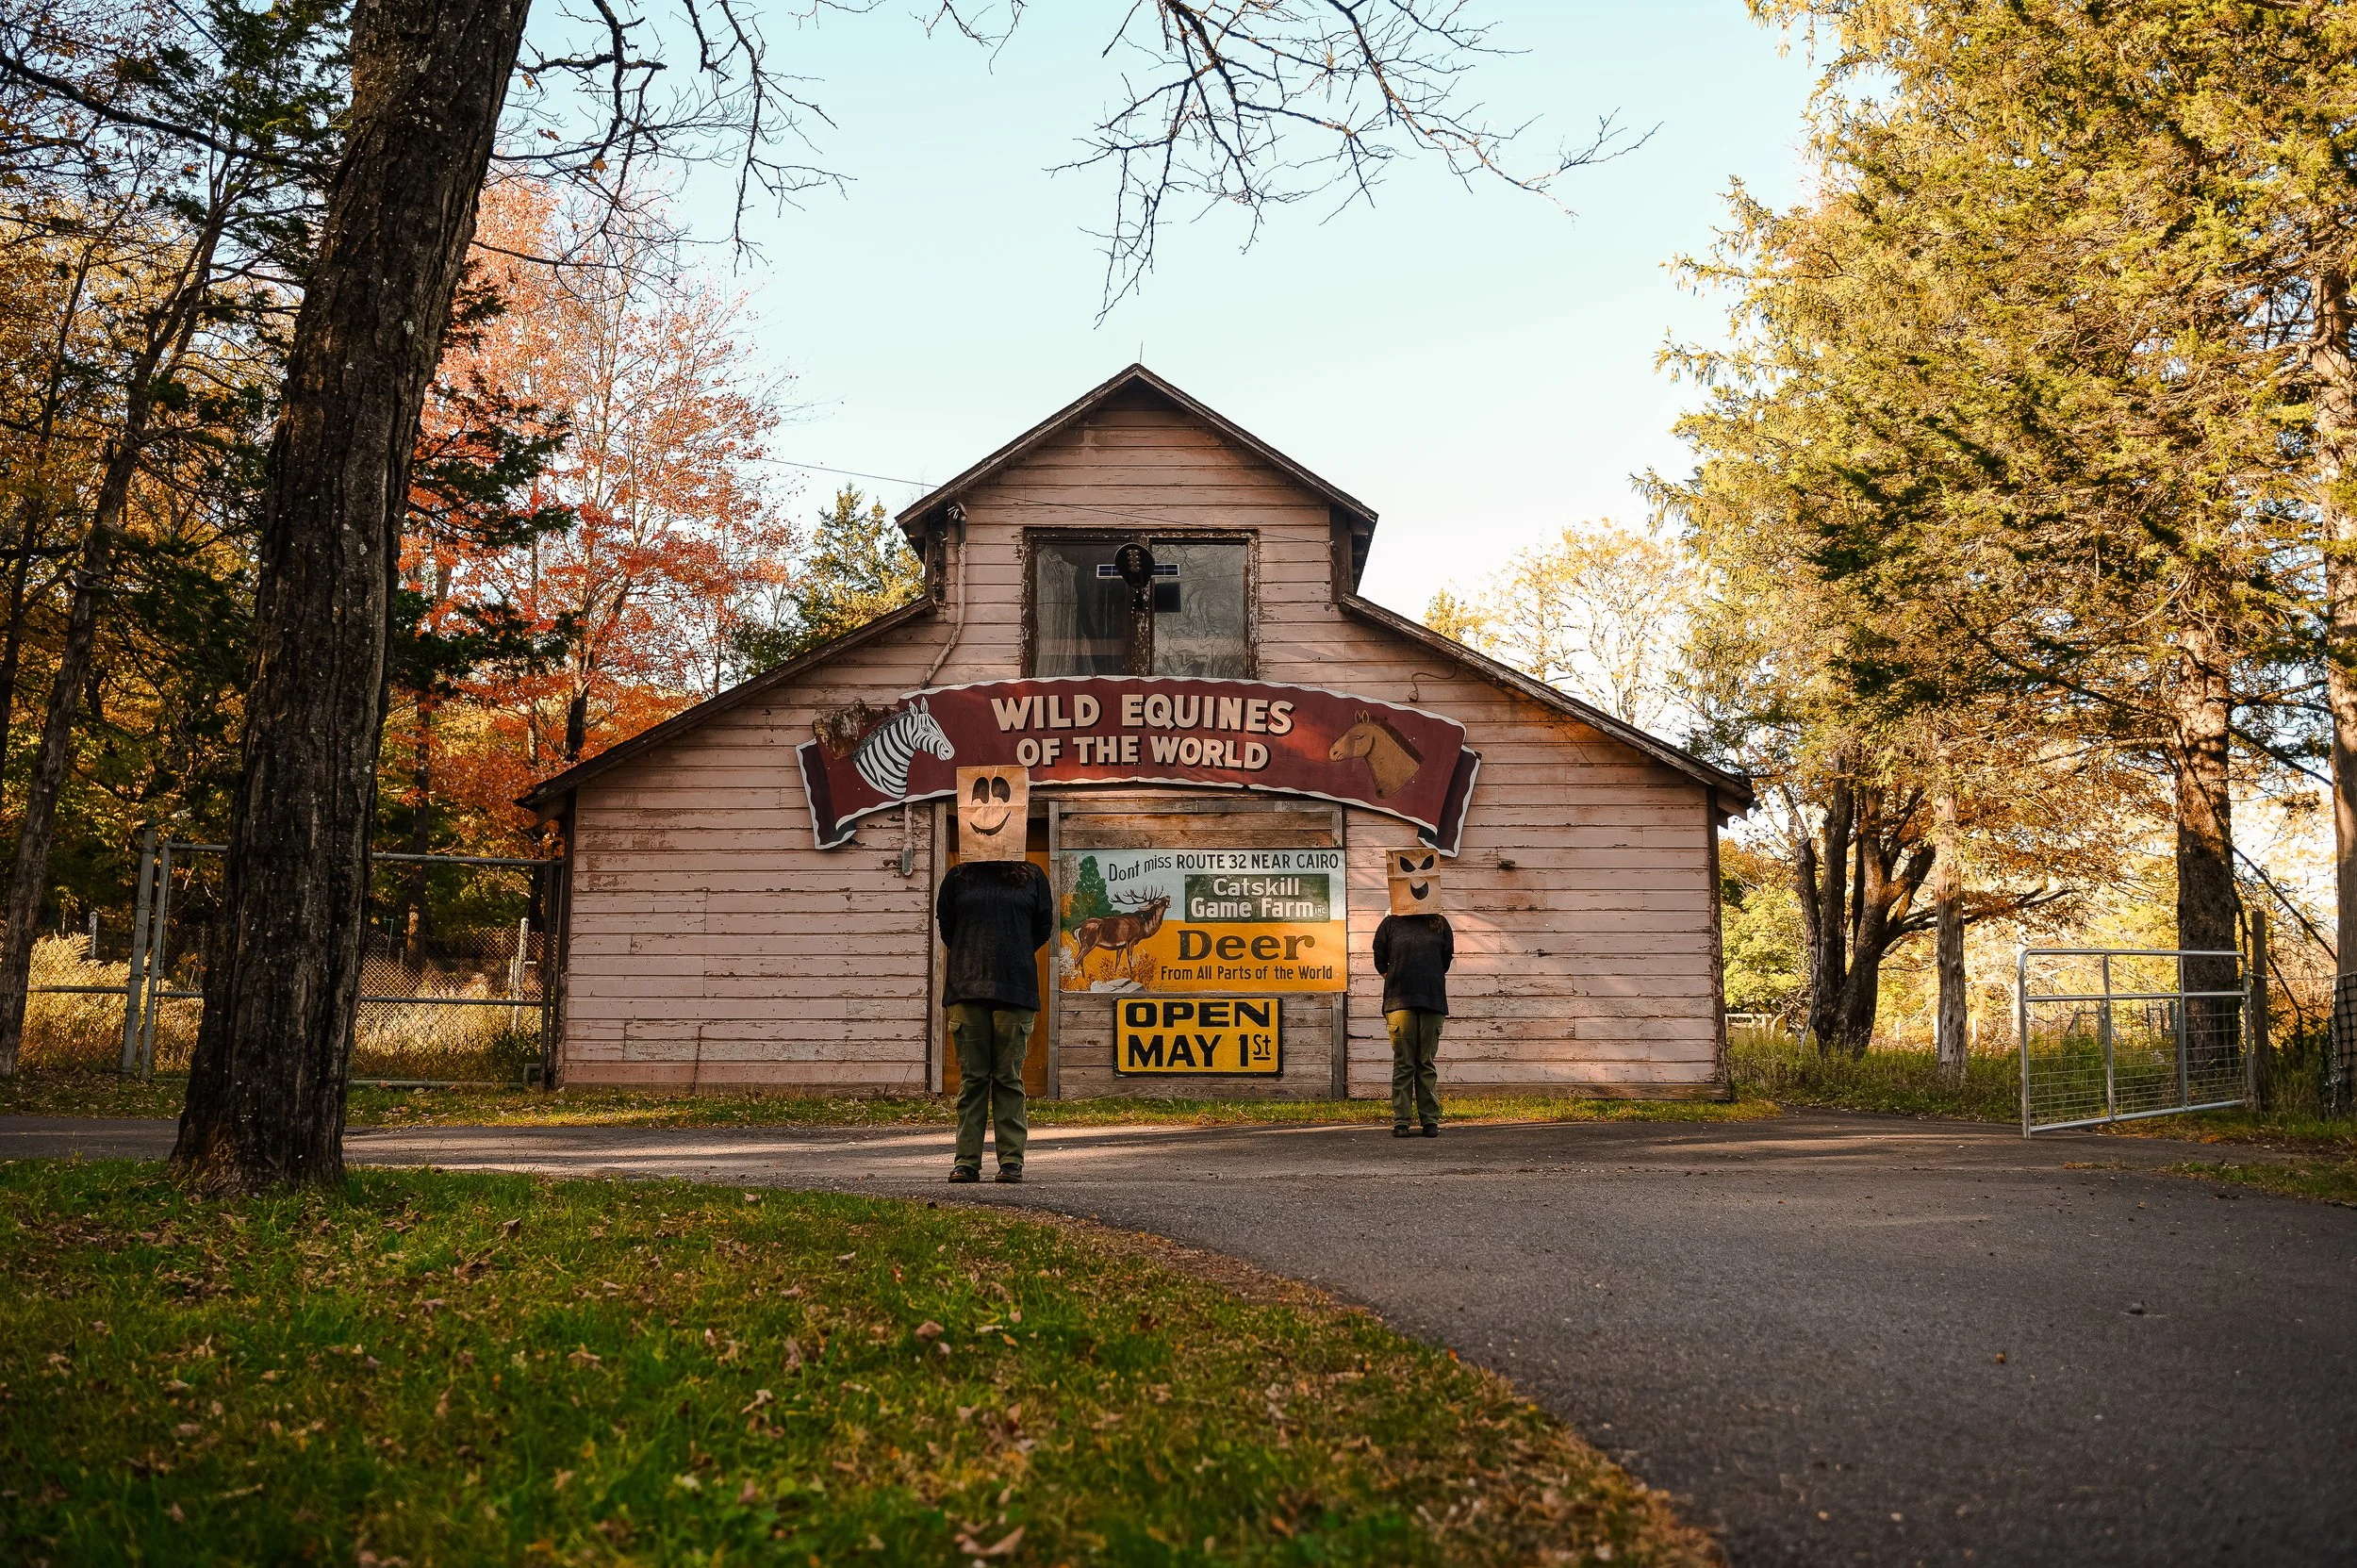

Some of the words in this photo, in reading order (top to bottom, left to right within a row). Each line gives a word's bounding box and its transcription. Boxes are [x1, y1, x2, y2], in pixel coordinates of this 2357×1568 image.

[991, 694, 1100, 731] WILD
[1121, 693, 1294, 734] EQUINES
[1016, 737, 1061, 767] OF
[1072, 735, 1139, 764] THE
[1149, 735, 1269, 769] WORLD
[1109, 860, 1140, 882] Dont
[1144, 855, 1172, 873] miss
[1177, 853, 1225, 869] ROUTE
[1228, 853, 1246, 869] 32
[1251, 853, 1291, 869] NEAR
[1296, 853, 1339, 869] CAIRO
[1212, 877, 1300, 897] Catskill
[1191, 897, 1253, 918] Game
[1261, 898, 1314, 918] Farm
[1177, 930, 1316, 961] Deer
[1161, 966, 1193, 981] From
[1196, 966, 1212, 981] All
[1217, 966, 1252, 981] Parts
[1255, 965, 1268, 980] of
[1274, 966, 1294, 981] the
[1297, 966, 1332, 980] World
[1125, 1001, 1271, 1029] OPEN
[1128, 1034, 1223, 1067] MAY
